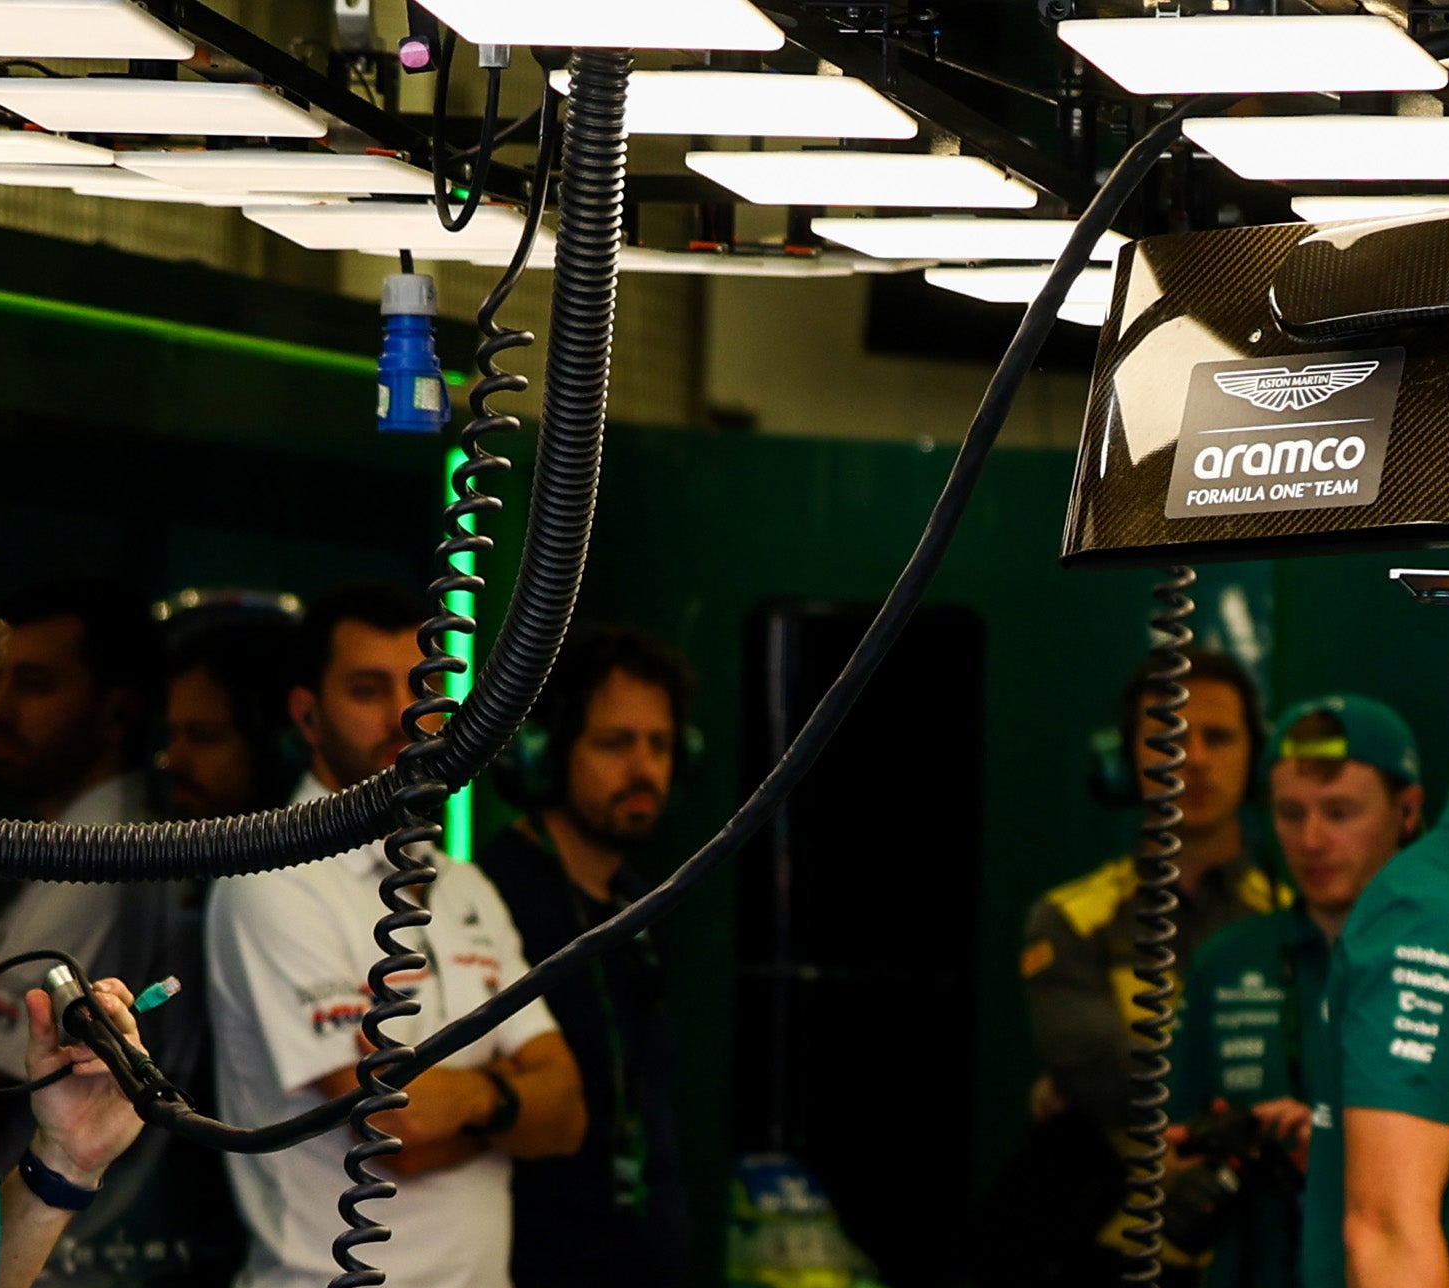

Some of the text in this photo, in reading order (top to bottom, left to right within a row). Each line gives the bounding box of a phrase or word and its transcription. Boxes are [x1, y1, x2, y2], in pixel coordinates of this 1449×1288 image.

[1258, 374, 1329, 389] ASTON MARTIN
[1194, 436, 1366, 480] aramco
[1186, 486, 1265, 506] FORMULA
[1315, 479, 1359, 497] TEAM
